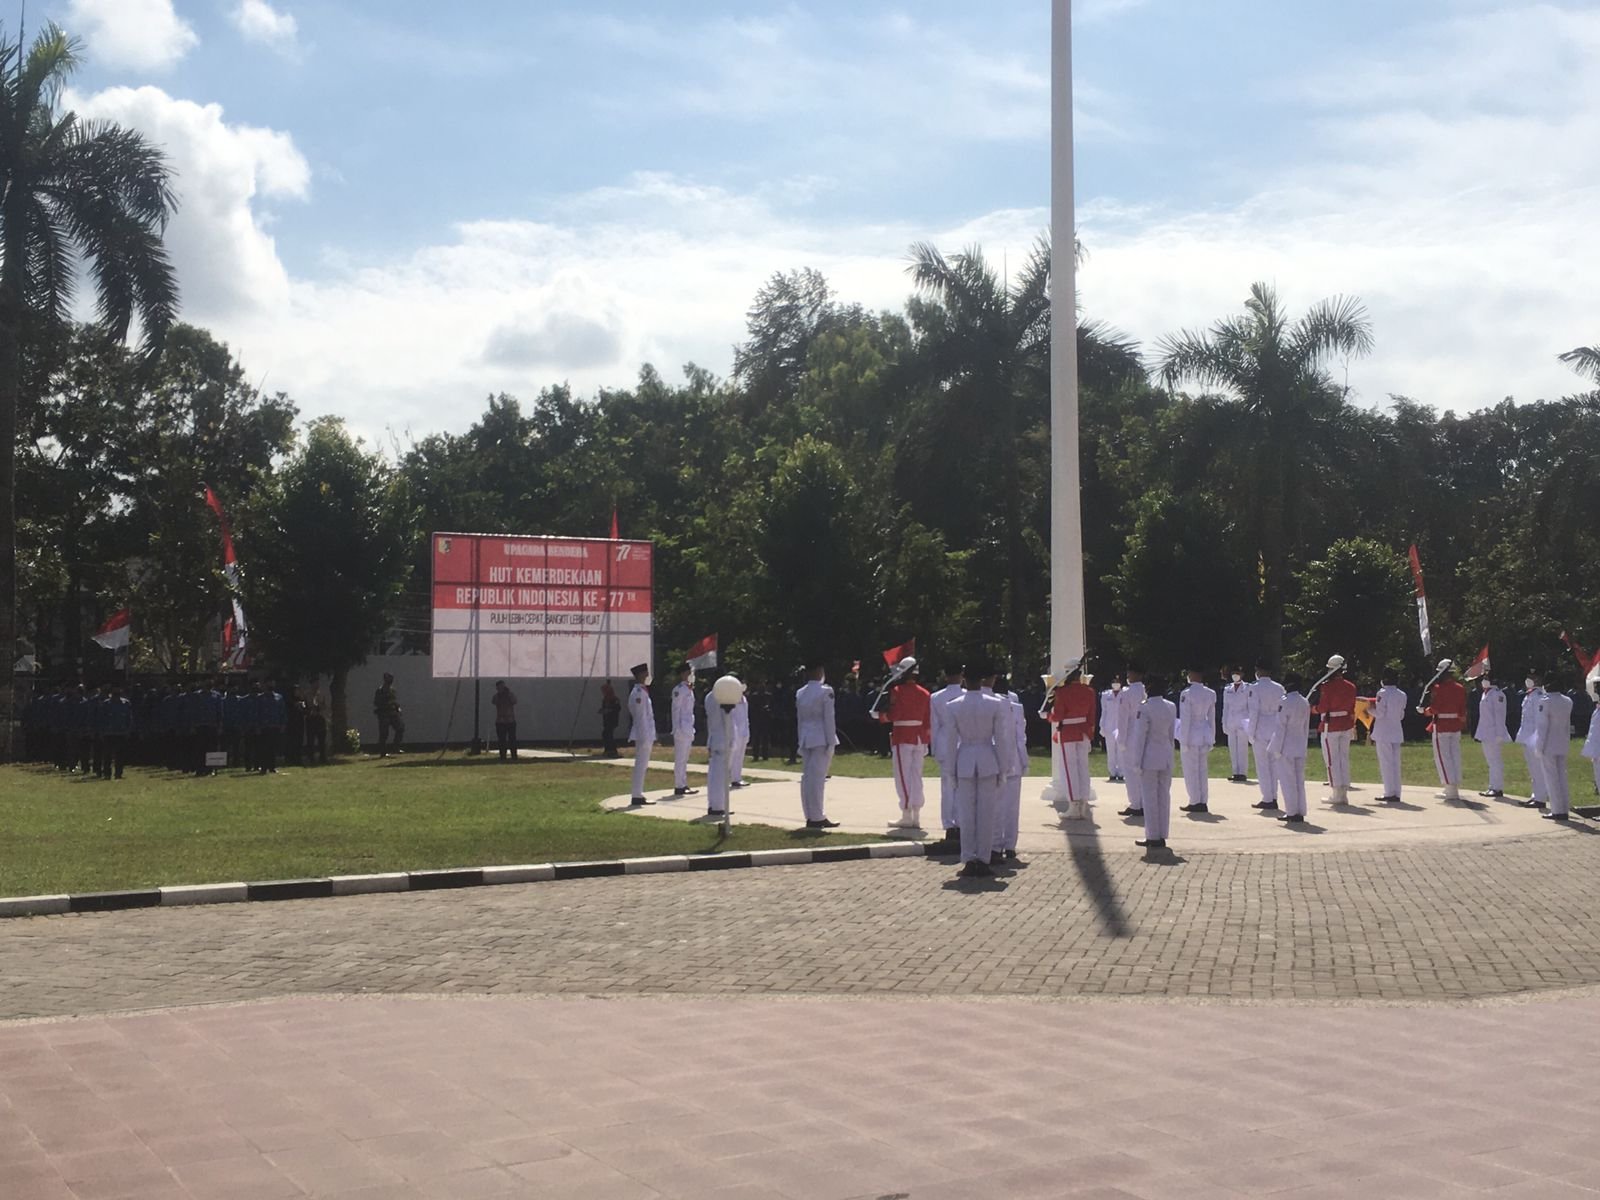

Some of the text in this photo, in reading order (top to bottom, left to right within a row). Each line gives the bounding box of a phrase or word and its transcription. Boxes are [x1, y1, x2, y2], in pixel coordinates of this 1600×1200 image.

[489, 566, 602, 585] HUT KEMERDEKAAN
[456, 588, 515, 605] REPUBLIK
[518, 589, 580, 606] INDONESIA
[583, 591, 598, 607] KE
[609, 592, 624, 607] 77
